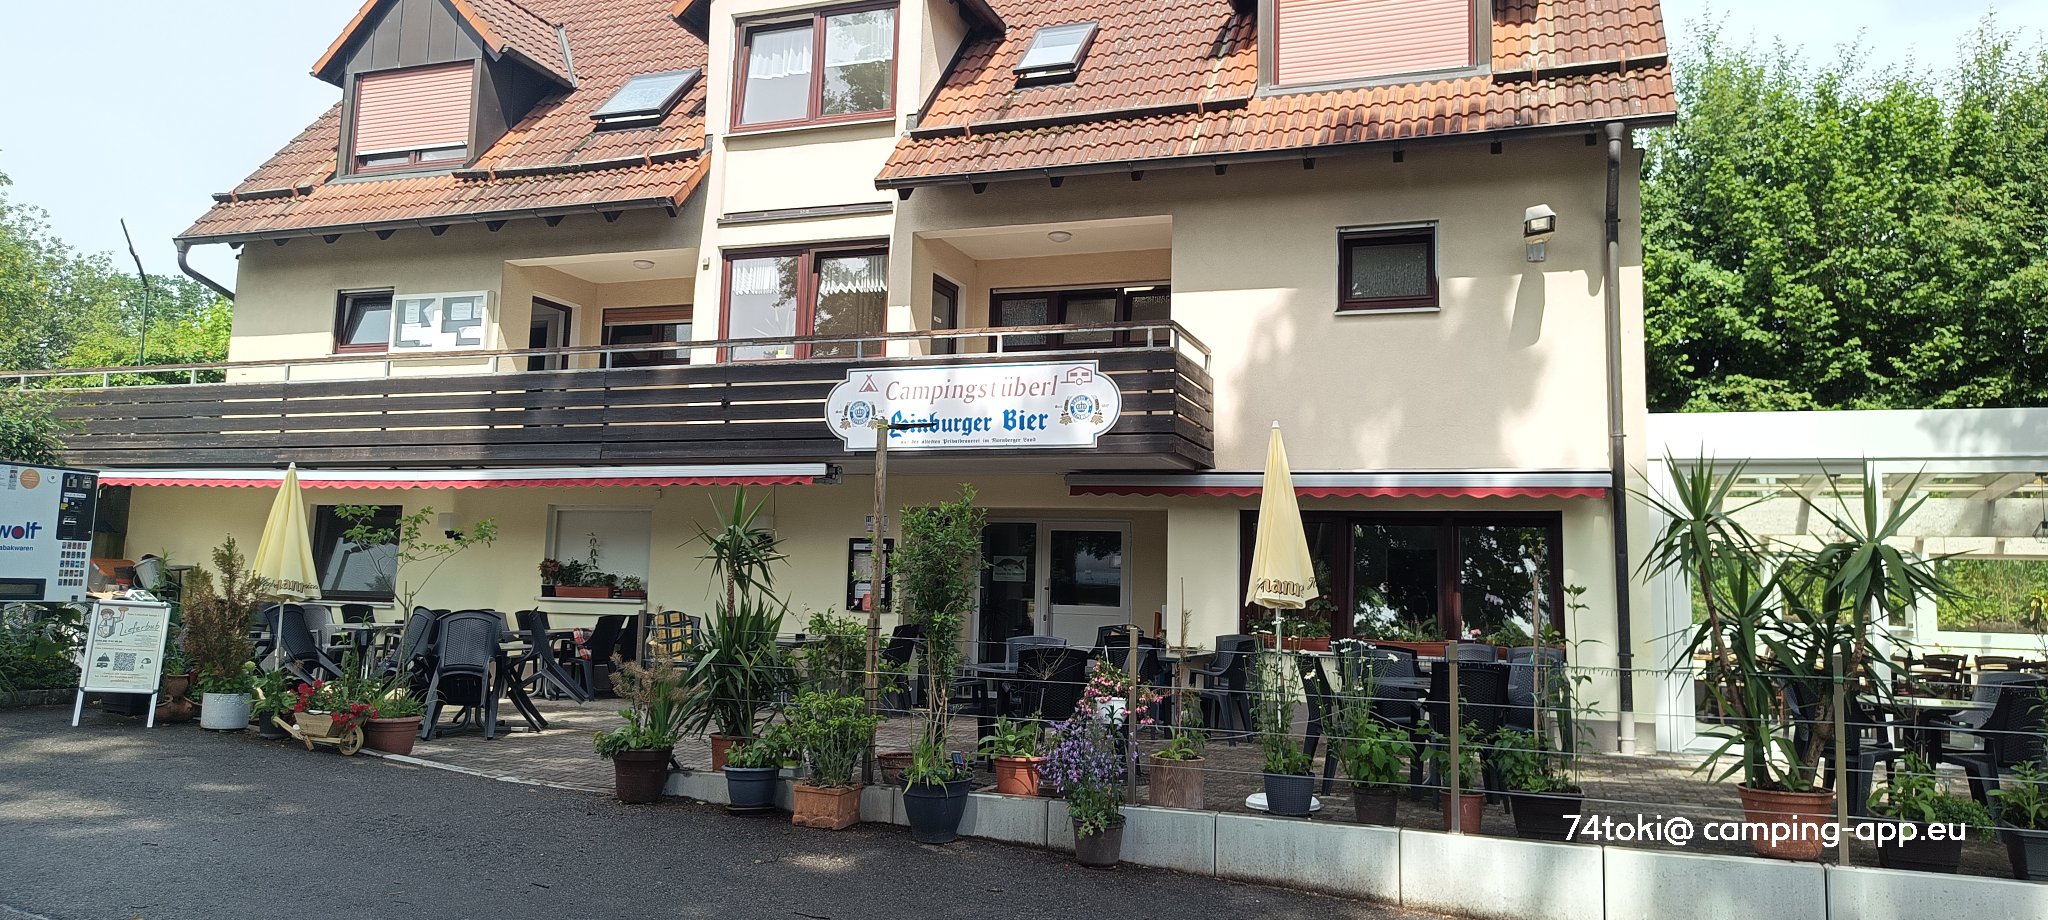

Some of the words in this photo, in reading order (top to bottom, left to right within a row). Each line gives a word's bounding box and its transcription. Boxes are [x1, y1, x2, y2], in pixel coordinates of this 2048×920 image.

[885, 375, 1059, 404] Campingstüberl
[1003, 408, 1049, 432] Bier
[0, 544, 34, 552] abakwaren
